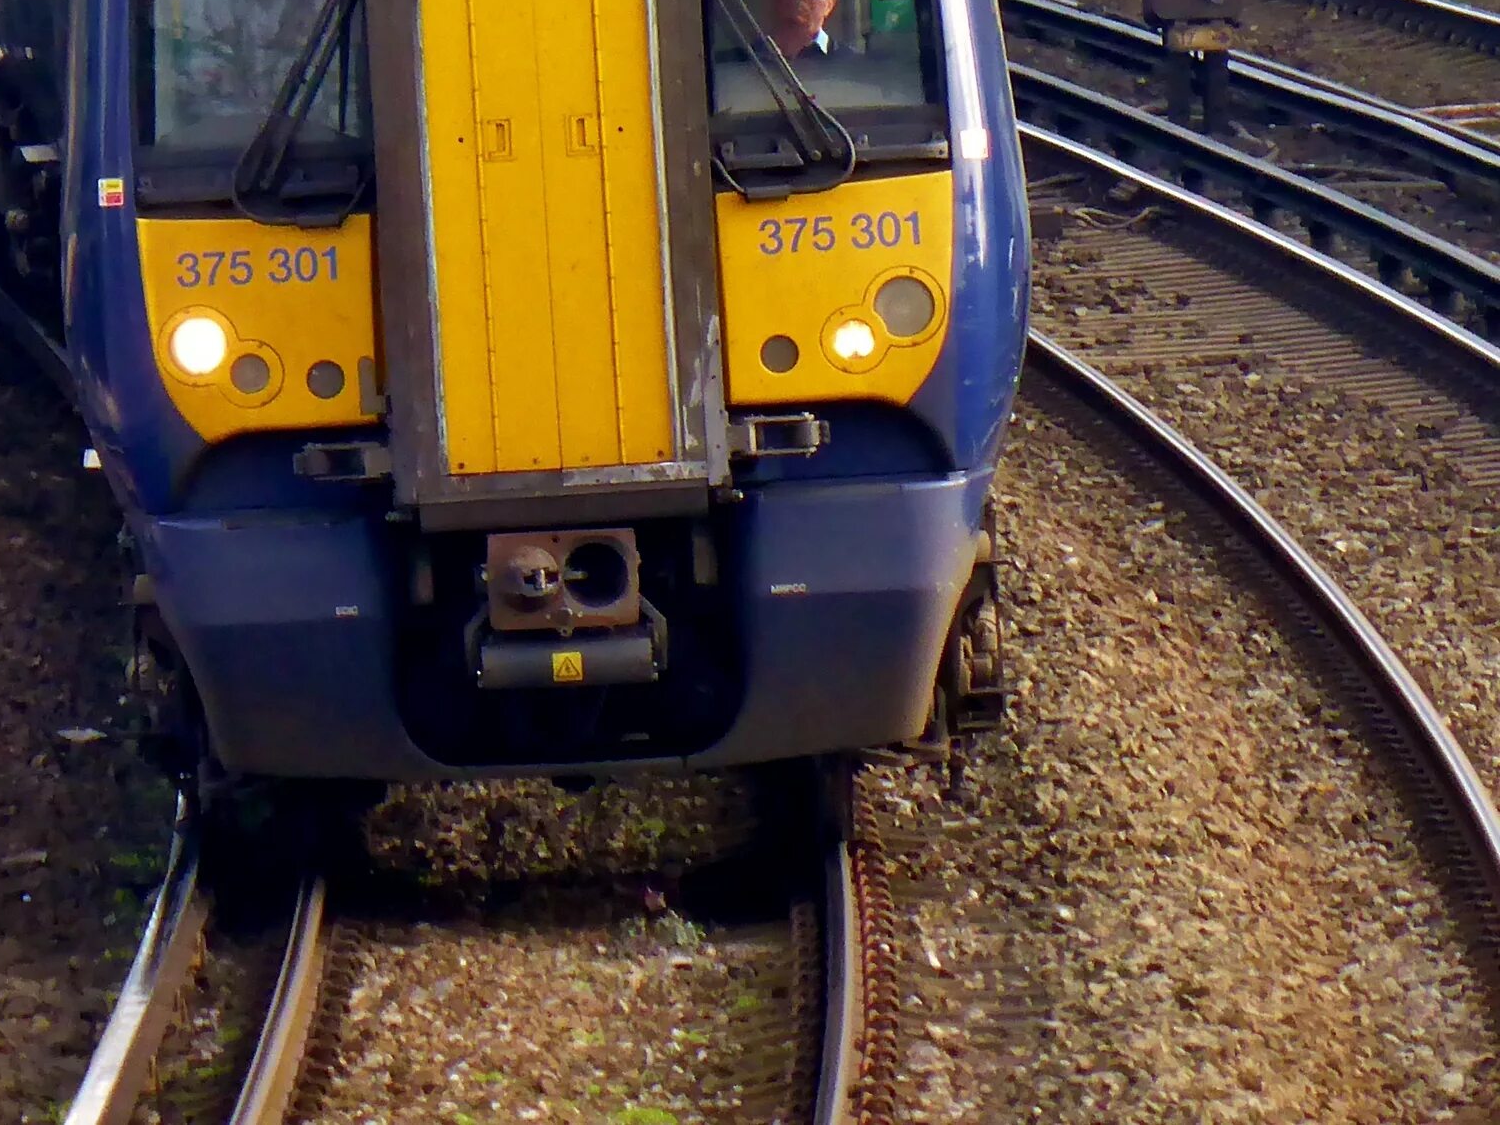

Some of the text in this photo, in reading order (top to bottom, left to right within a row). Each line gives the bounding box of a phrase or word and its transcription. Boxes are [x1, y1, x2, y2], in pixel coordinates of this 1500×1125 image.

[758, 210, 921, 256] 375 301
[176, 245, 339, 289] 375 301
